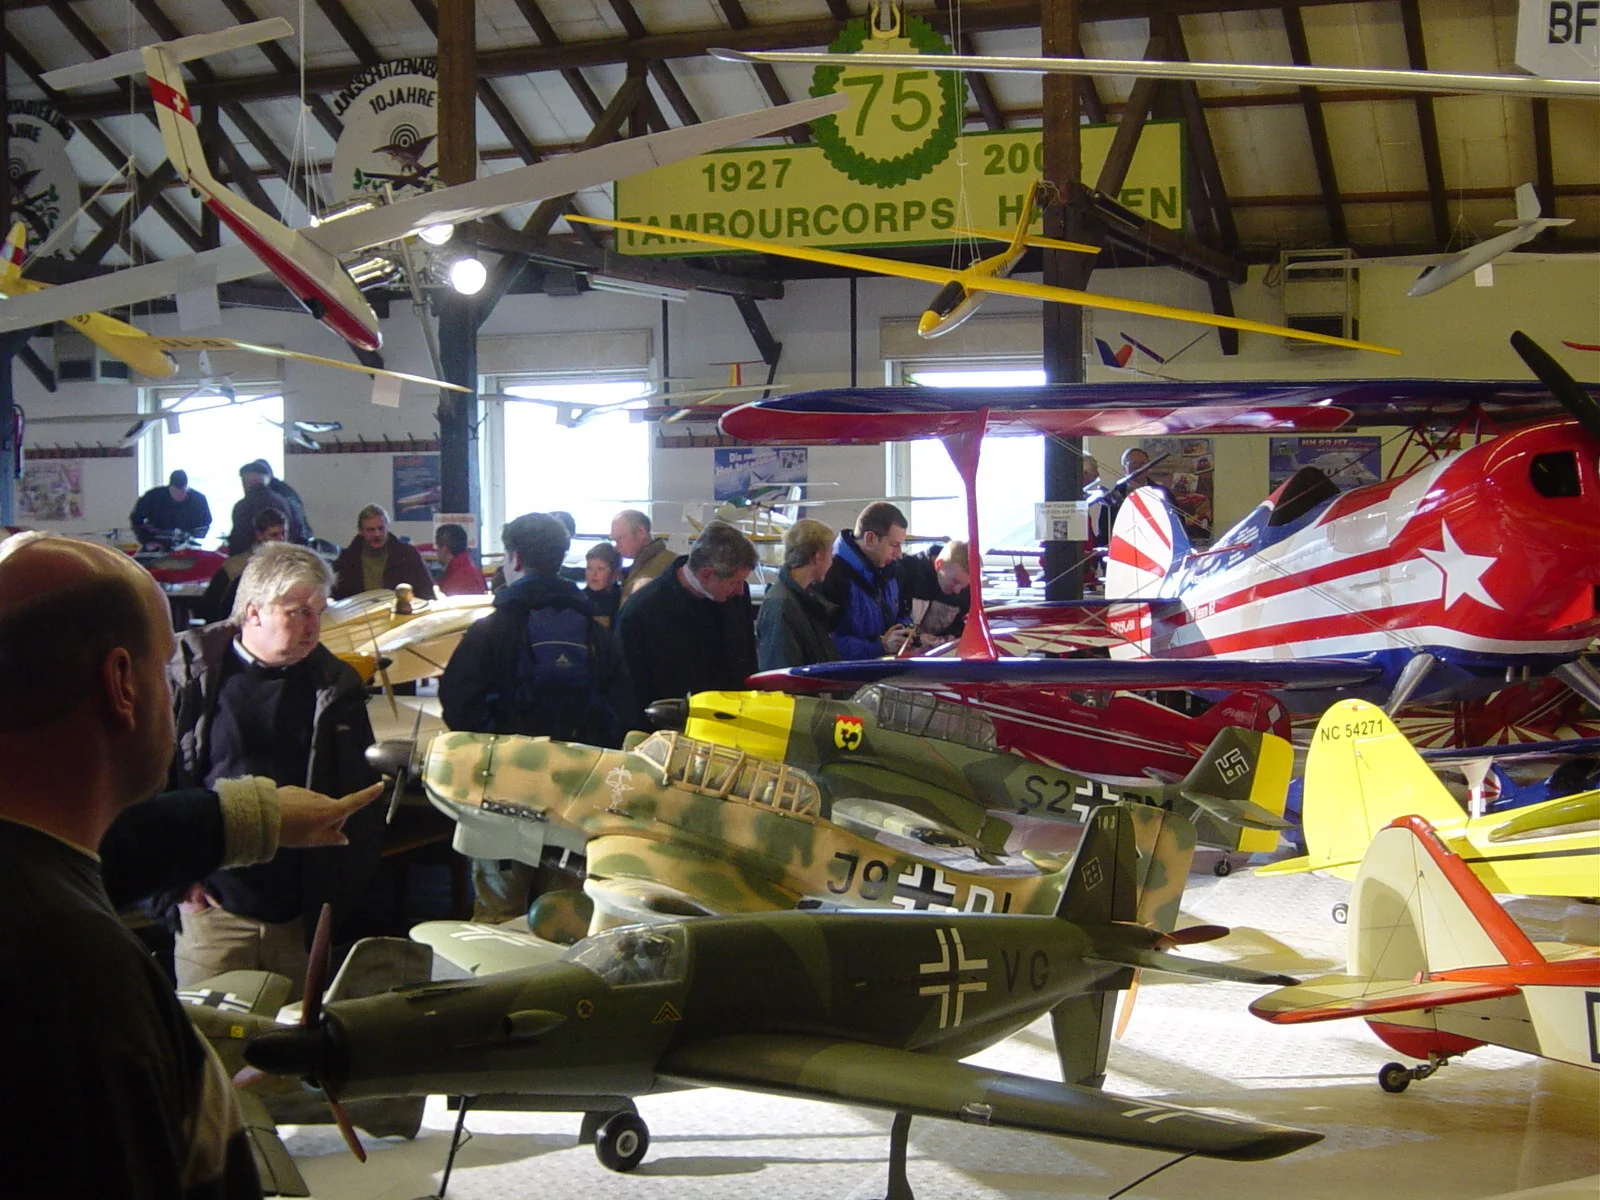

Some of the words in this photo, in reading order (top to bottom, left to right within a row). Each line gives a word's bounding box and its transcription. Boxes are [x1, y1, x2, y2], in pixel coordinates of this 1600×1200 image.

[842, 71, 932, 137] 75
[702, 158, 792, 192] 1927
[620, 198, 955, 246] TAMBOURCORPS
[1321, 726, 1340, 742] NC
[1345, 719, 1382, 738] 54271
[1020, 775, 1071, 814] S2
